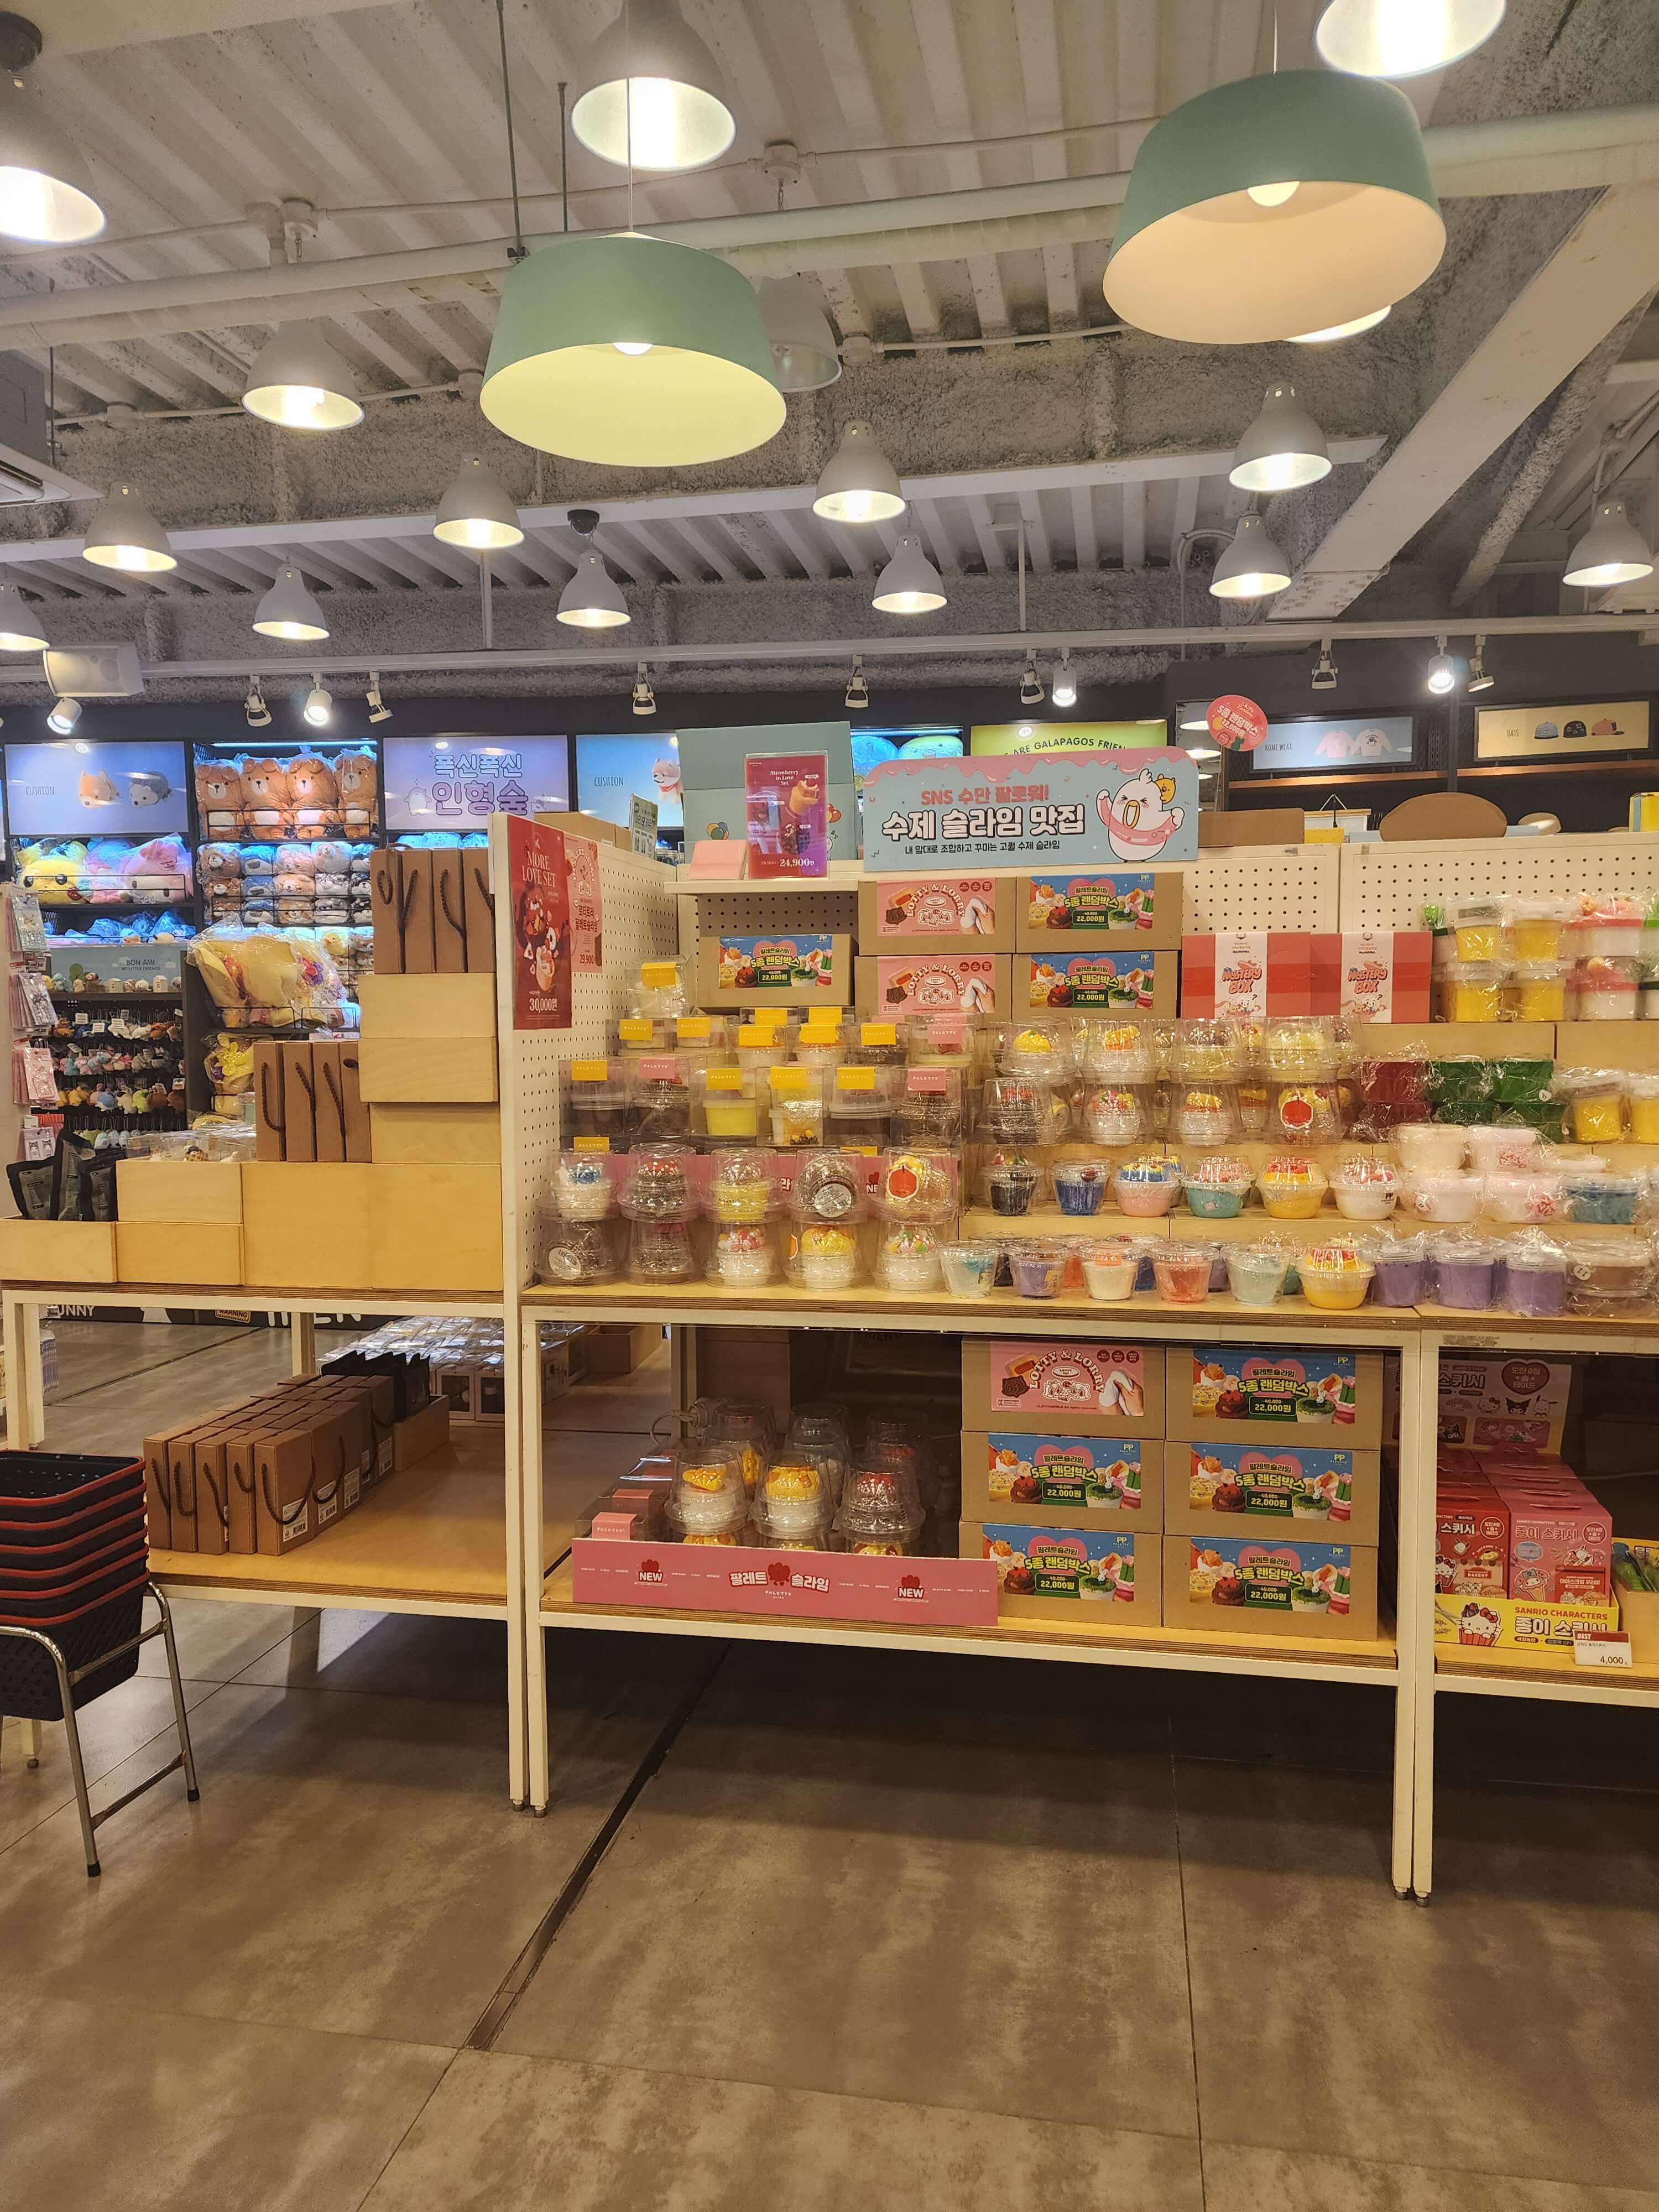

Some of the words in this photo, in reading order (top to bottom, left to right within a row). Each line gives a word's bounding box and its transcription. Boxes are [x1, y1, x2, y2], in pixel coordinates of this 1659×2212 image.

[1229, 712, 1260, 737] 랜덤박스
[1507, 729, 1520, 738] HATS
[1013, 744, 1031, 755] ARE
[1034, 737, 1094, 750] GALAPAGOS
[1265, 744, 1279, 752] HOME
[1279, 743, 1292, 751] WEAR
[434, 753, 523, 779] 폭신폭신
[593, 776, 624, 787] CUSHION
[25, 786, 55, 796] CUSHION
[431, 779, 529, 816] 인형숲
[920, 789, 953, 805] SNS
[957, 786, 990, 805] 수만
[882, 810, 936, 841] 수제
[942, 806, 1023, 839] 슬라임
[1030, 804, 1085, 837] 맛집
[905, 845, 914, 854] 내
[915, 844, 939, 854] 맘대로
[940, 843, 973, 853] 조합하고
[974, 842, 998, 853] 꾸미는
[1017, 841, 1034, 851] 수제
[1036, 839, 1061, 851] 슬라임
[527, 851, 550, 870] MORE
[522, 865, 542, 884] LOVE
[543, 870, 556, 888] SET
[906, 885, 928, 917] LOTTY
[942, 884, 966, 916] LORRY
[1064, 896, 1080, 907] 5종
[1082, 895, 1119, 908] 랜덤박스
[580, 954, 594, 965] 29,900
[751, 957, 765, 968] 5종
[766, 955, 800, 968] 랜덤박스
[906, 964, 928, 996] LOTTY
[931, 962, 940, 971] &
[942, 964, 966, 996] LORRY
[1065, 975, 1080, 985] 5종
[1082, 974, 1119, 987] 랜덤박스
[1221, 968, 1262, 982] MYSTERY
[1347, 968, 1388, 982] MYSTERY
[1229, 980, 1254, 994] BOX
[1355, 980, 1379, 994] BOX
[529, 997, 558, 1013] 30,000원
[218, 1310, 248, 1318] WARNING
[1030, 1351, 1056, 1389] LOTTY
[1061, 1349, 1071, 1359] &
[1074, 1352, 1105, 1393] LORRY
[1252, 1369, 1296, 1378] 팔레트슬라임
[1239, 1379, 1259, 1393] 5종
[1260, 1378, 1309, 1396] 랜덤박스
[1438, 1373, 1485, 1389] 스퀴시
[1255, 1404, 1291, 1412] 22,000원
[1044, 1455, 1084, 1464] 팔레트슬라임
[1031, 1467, 1050, 1479] 5종
[1051, 1465, 1098, 1482] 랜덤박스
[1249, 1463, 1292, 1473] 팔레트슬라임
[1235, 1474, 1256, 1486] 5종
[1258, 1473, 1306, 1492] 랜덤박스
[1047, 1489, 1082, 1498] 22,000원
[1251, 1498, 1287, 1508] 22,000원
[1441, 1522, 1475, 1535] 스퀴시
[1515, 1526, 1540, 1540] 종이
[1542, 1527, 1578, 1542] 스퀴시
[1037, 1546, 1078, 1556] 팔레트슬라임
[1025, 1557, 1045, 1570] 5종
[1046, 1556, 1091, 1574] 랜덤박스
[1248, 1557, 1291, 1567] 팔레트슬라임
[639, 1572, 663, 1582] NEW
[729, 1571, 768, 1587] 팔레트
[791, 1573, 830, 1593] 슬라임
[1235, 1567, 1255, 1580] 5종
[1256, 1566, 1305, 1586] 랜덤박스
[1040, 1580, 1074, 1590] 22,000원
[898, 1588, 924, 1599] NEW
[1250, 1591, 1286, 1601] 22,000원
[1515, 1606, 1548, 1616] SANRIO
[1551, 1610, 1608, 1620] CHARACTERS
[1515, 1616, 1551, 1635] 종이
[1600, 1656, 1624, 1665] 4,000
